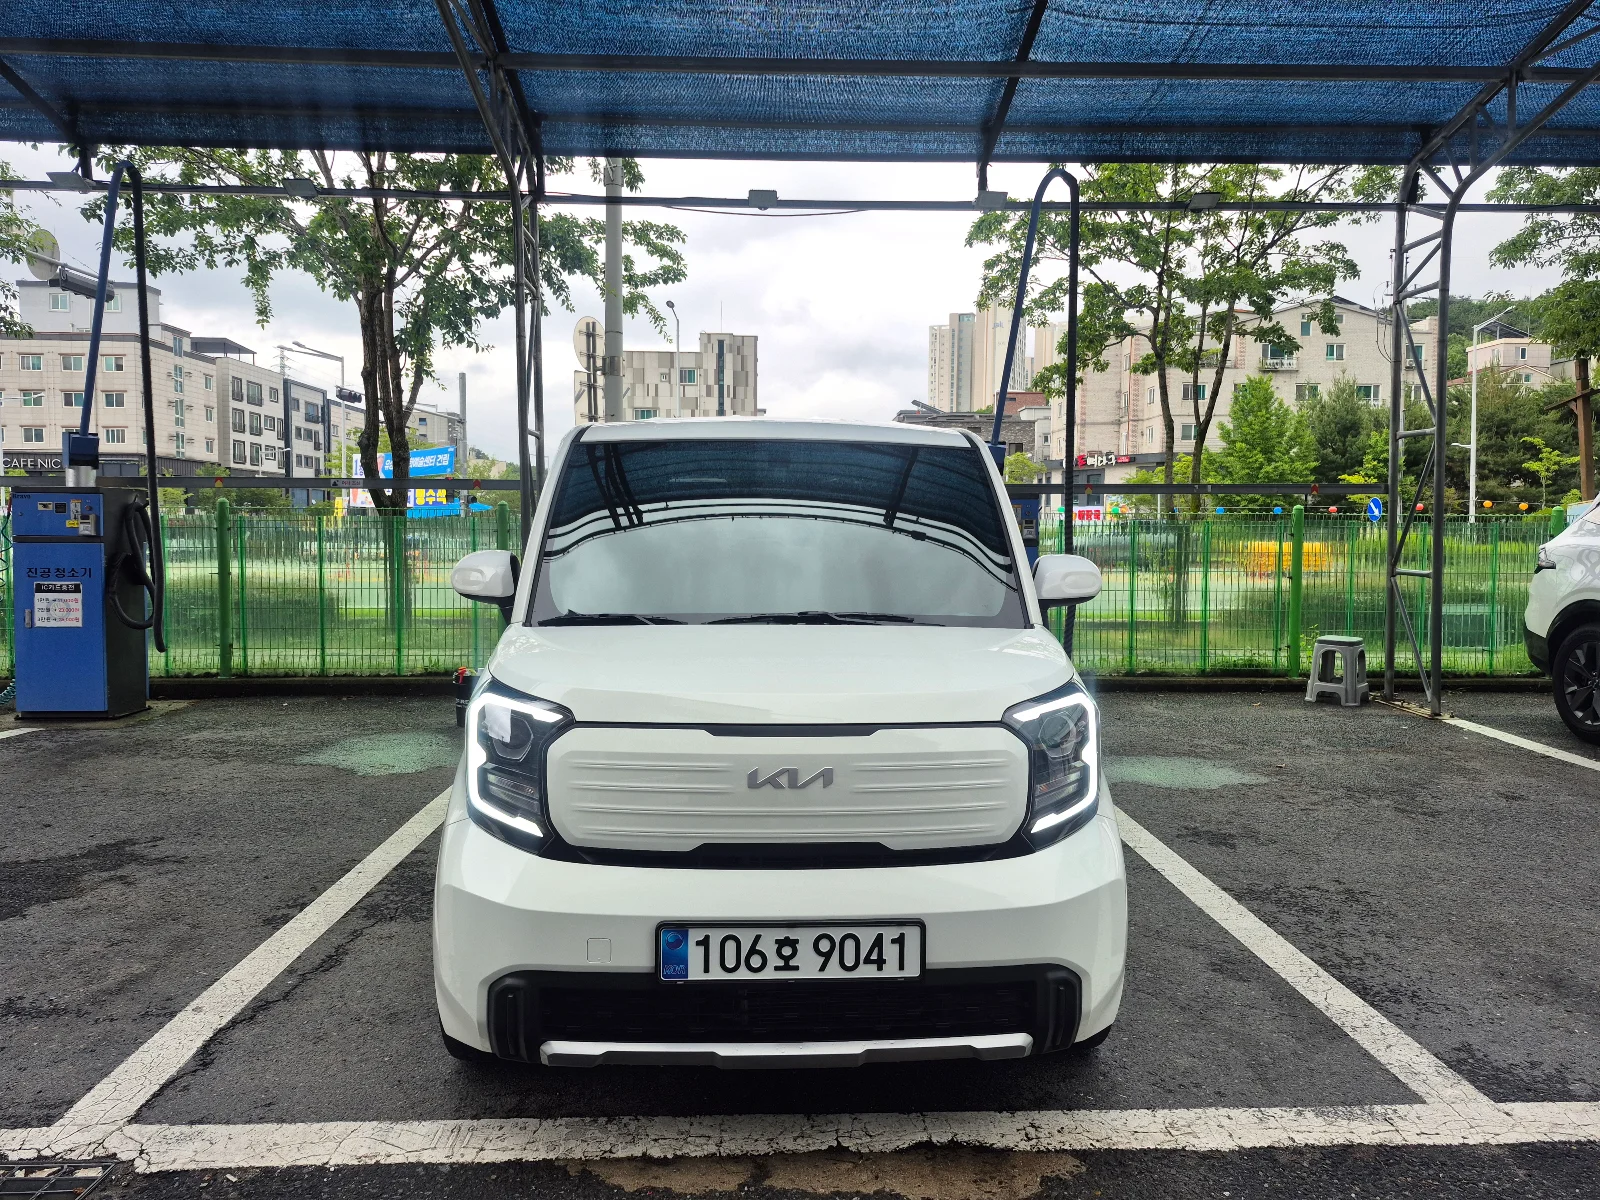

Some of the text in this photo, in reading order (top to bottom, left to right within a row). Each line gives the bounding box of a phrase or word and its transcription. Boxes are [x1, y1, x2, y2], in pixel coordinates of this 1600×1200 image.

[2, 458, 61, 469] CAFE NIC
[26, 567, 92, 578] 진공청소기
[747, 766, 834, 789] KIA
[695, 932, 906, 974] 106호 9041
